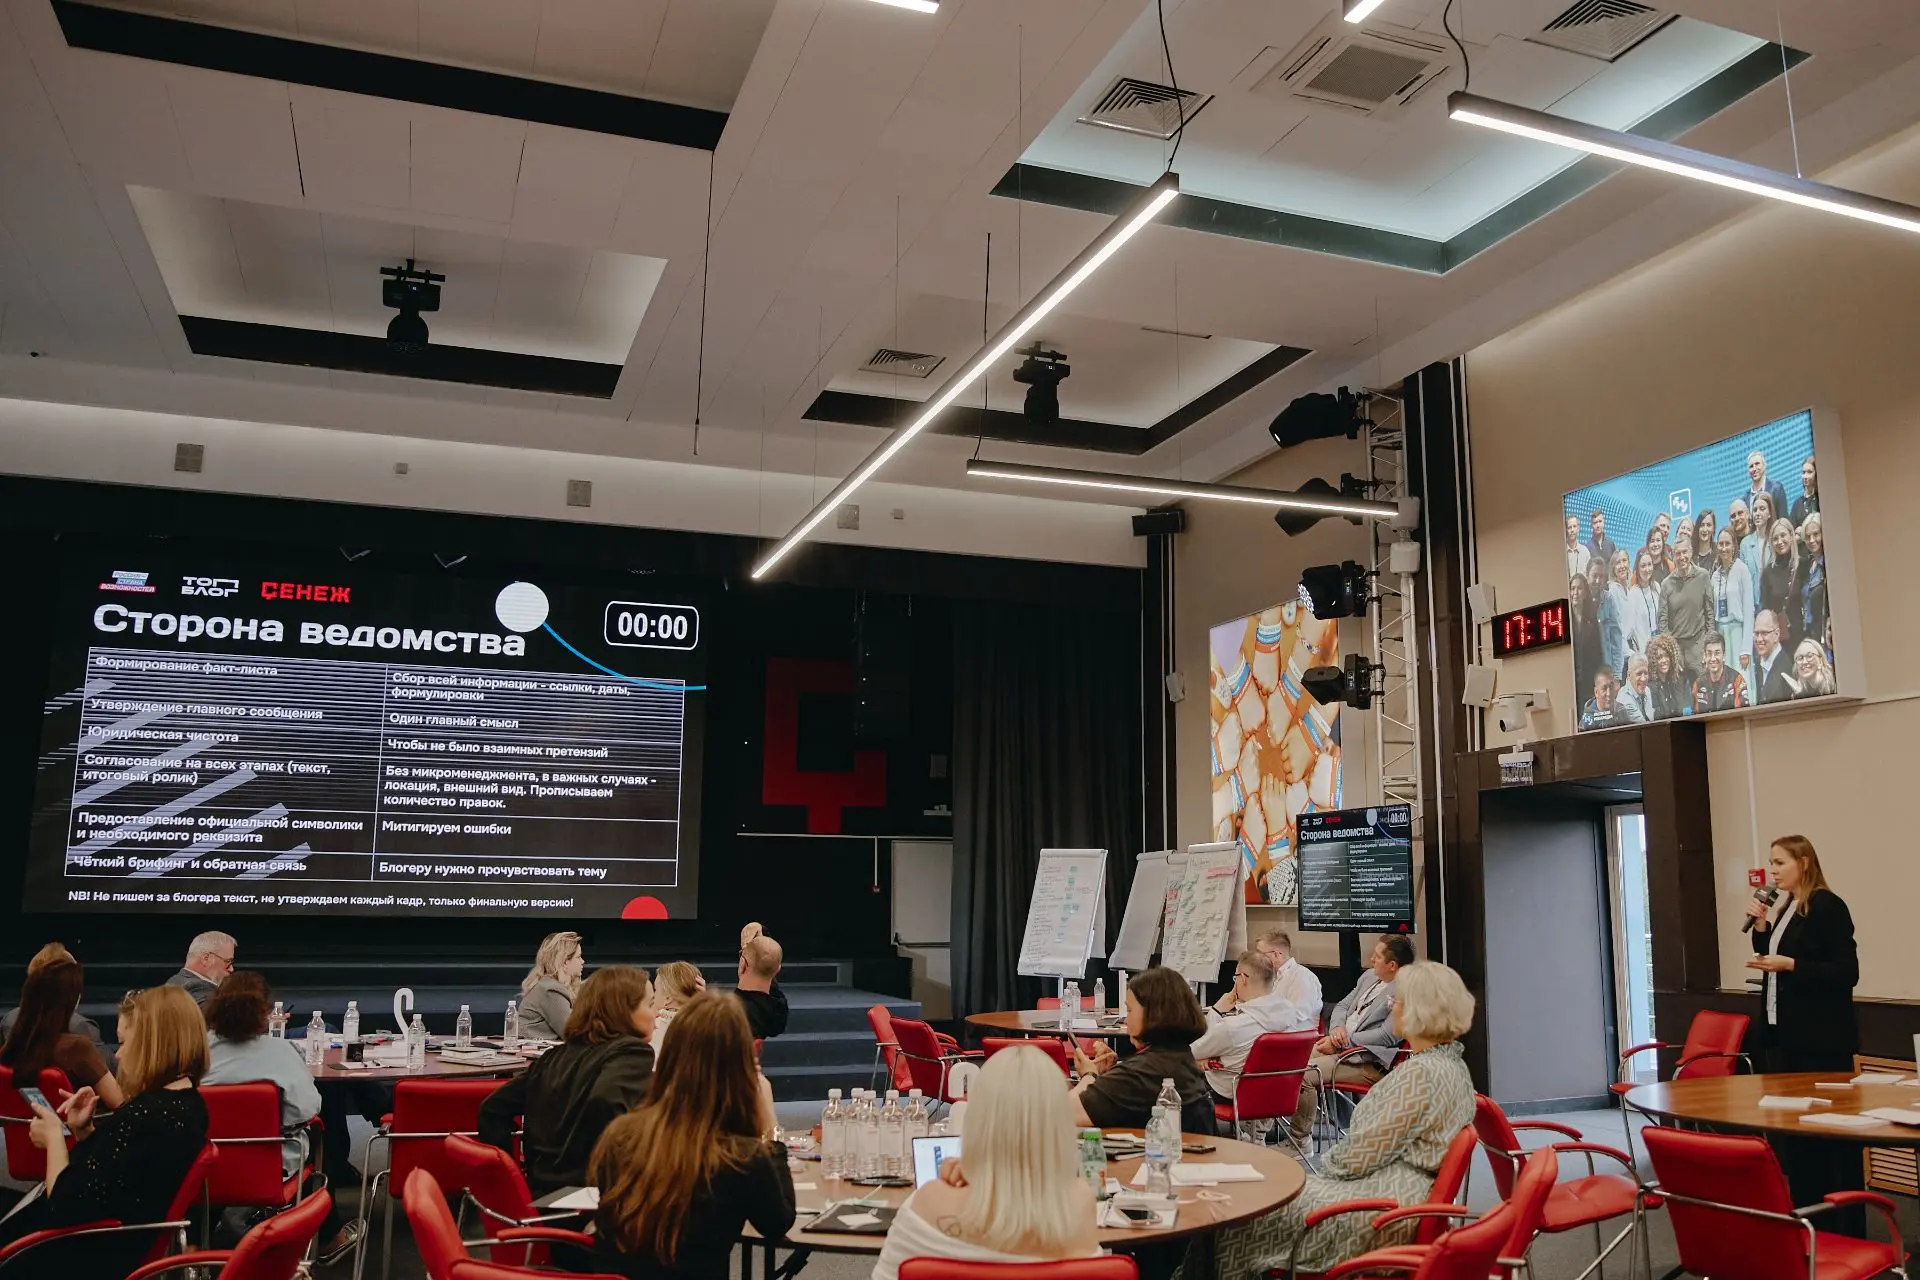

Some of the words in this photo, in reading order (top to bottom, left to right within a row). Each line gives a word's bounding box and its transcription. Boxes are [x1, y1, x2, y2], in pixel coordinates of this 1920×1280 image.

[183, 576, 240, 589] ТОП
[181, 586, 239, 598] БЛОГ
[93, 603, 284, 643] Сторона
[299, 620, 526, 657] ведомства
[617, 611, 688, 640] 00:00
[1504, 607, 1563, 648] 17:14
[95, 655, 199, 673] Формирование
[202, 661, 278, 676] факт-листа
[392, 672, 425, 686] Сбор
[428, 674, 458, 686] всей
[460, 676, 538, 691] информации
[549, 682, 596, 694] ссылки,
[598, 684, 631, 696] даты,
[391, 687, 484, 701] формулировки
[91, 698, 183, 714] Утверждение
[186, 703, 246, 716] главного
[249, 705, 323, 719] сообщения
[389, 713, 423, 725] Один
[425, 714, 477, 728] главный
[480, 717, 519, 729] смысл
[87, 726, 183, 741] Юридическая
[186, 730, 239, 743] чистота
[388, 738, 428, 751] Чтобы
[430, 741, 446, 751] не
[449, 741, 480, 753] было
[483, 744, 543, 756] взаимных
[545, 746, 609, 758] претензий
[84, 754, 183, 768] Согласование
[185, 759, 201, 769] на
[204, 759, 236, 770] всех
[239, 760, 284, 773] этапах
[287, 762, 330, 775] (текст,
[83, 769, 150, 782] итоговый
[152, 771, 199, 785] ролик)
[386, 765, 410, 776] Без
[411, 767, 539, 783] микроменеджмента,
[542, 772, 550, 782] в
[552, 772, 598, 784] важных
[601, 774, 648, 786] случаях
[384, 780, 441, 793] локация,
[443, 781, 499, 795] внешний
[501, 784, 526, 796] вид.
[530, 785, 613, 798] Прописываем
[383, 795, 456, 808] количество
[459, 798, 507, 809] правок.
[78, 812, 195, 826] Предоставление
[197, 816, 288, 830] официальной
[291, 819, 363, 831] символики
[382, 821, 461, 835] Митигируем
[464, 823, 512, 835] ошибки
[76, 829, 86, 839] и
[89, 828, 190, 842] необходимого
[192, 832, 263, 844] реквизита
[1301, 831, 1331, 841] Сторона
[1333, 827, 1374, 838] ведомства
[73, 855, 125, 868] Чёткий
[128, 857, 188, 871] брифинг
[191, 859, 200, 869] и
[203, 858, 266, 872] обратная
[269, 860, 307, 872] связь
[379, 862, 432, 876] Блогеру
[434, 864, 475, 876] нужно
[478, 866, 575, 878] прочувствовать
[578, 867, 608, 879] тему
[68, 890, 90, 901] NB!
[93, 891, 110, 901] Не
[113, 892, 154, 902] пишем
[156, 893, 171, 902] за
[173, 892, 221, 904] блогера
[223, 894, 258, 904] текст,
[261, 895, 275, 904] не
[278, 894, 348, 906] утверждаем
[350, 895, 394, 907] каждый
[396, 896, 426, 907] кадр,
[429, 896, 465, 907] только
[468, 896, 529, 909] финальную
[531, 898, 574, 908] версию!
